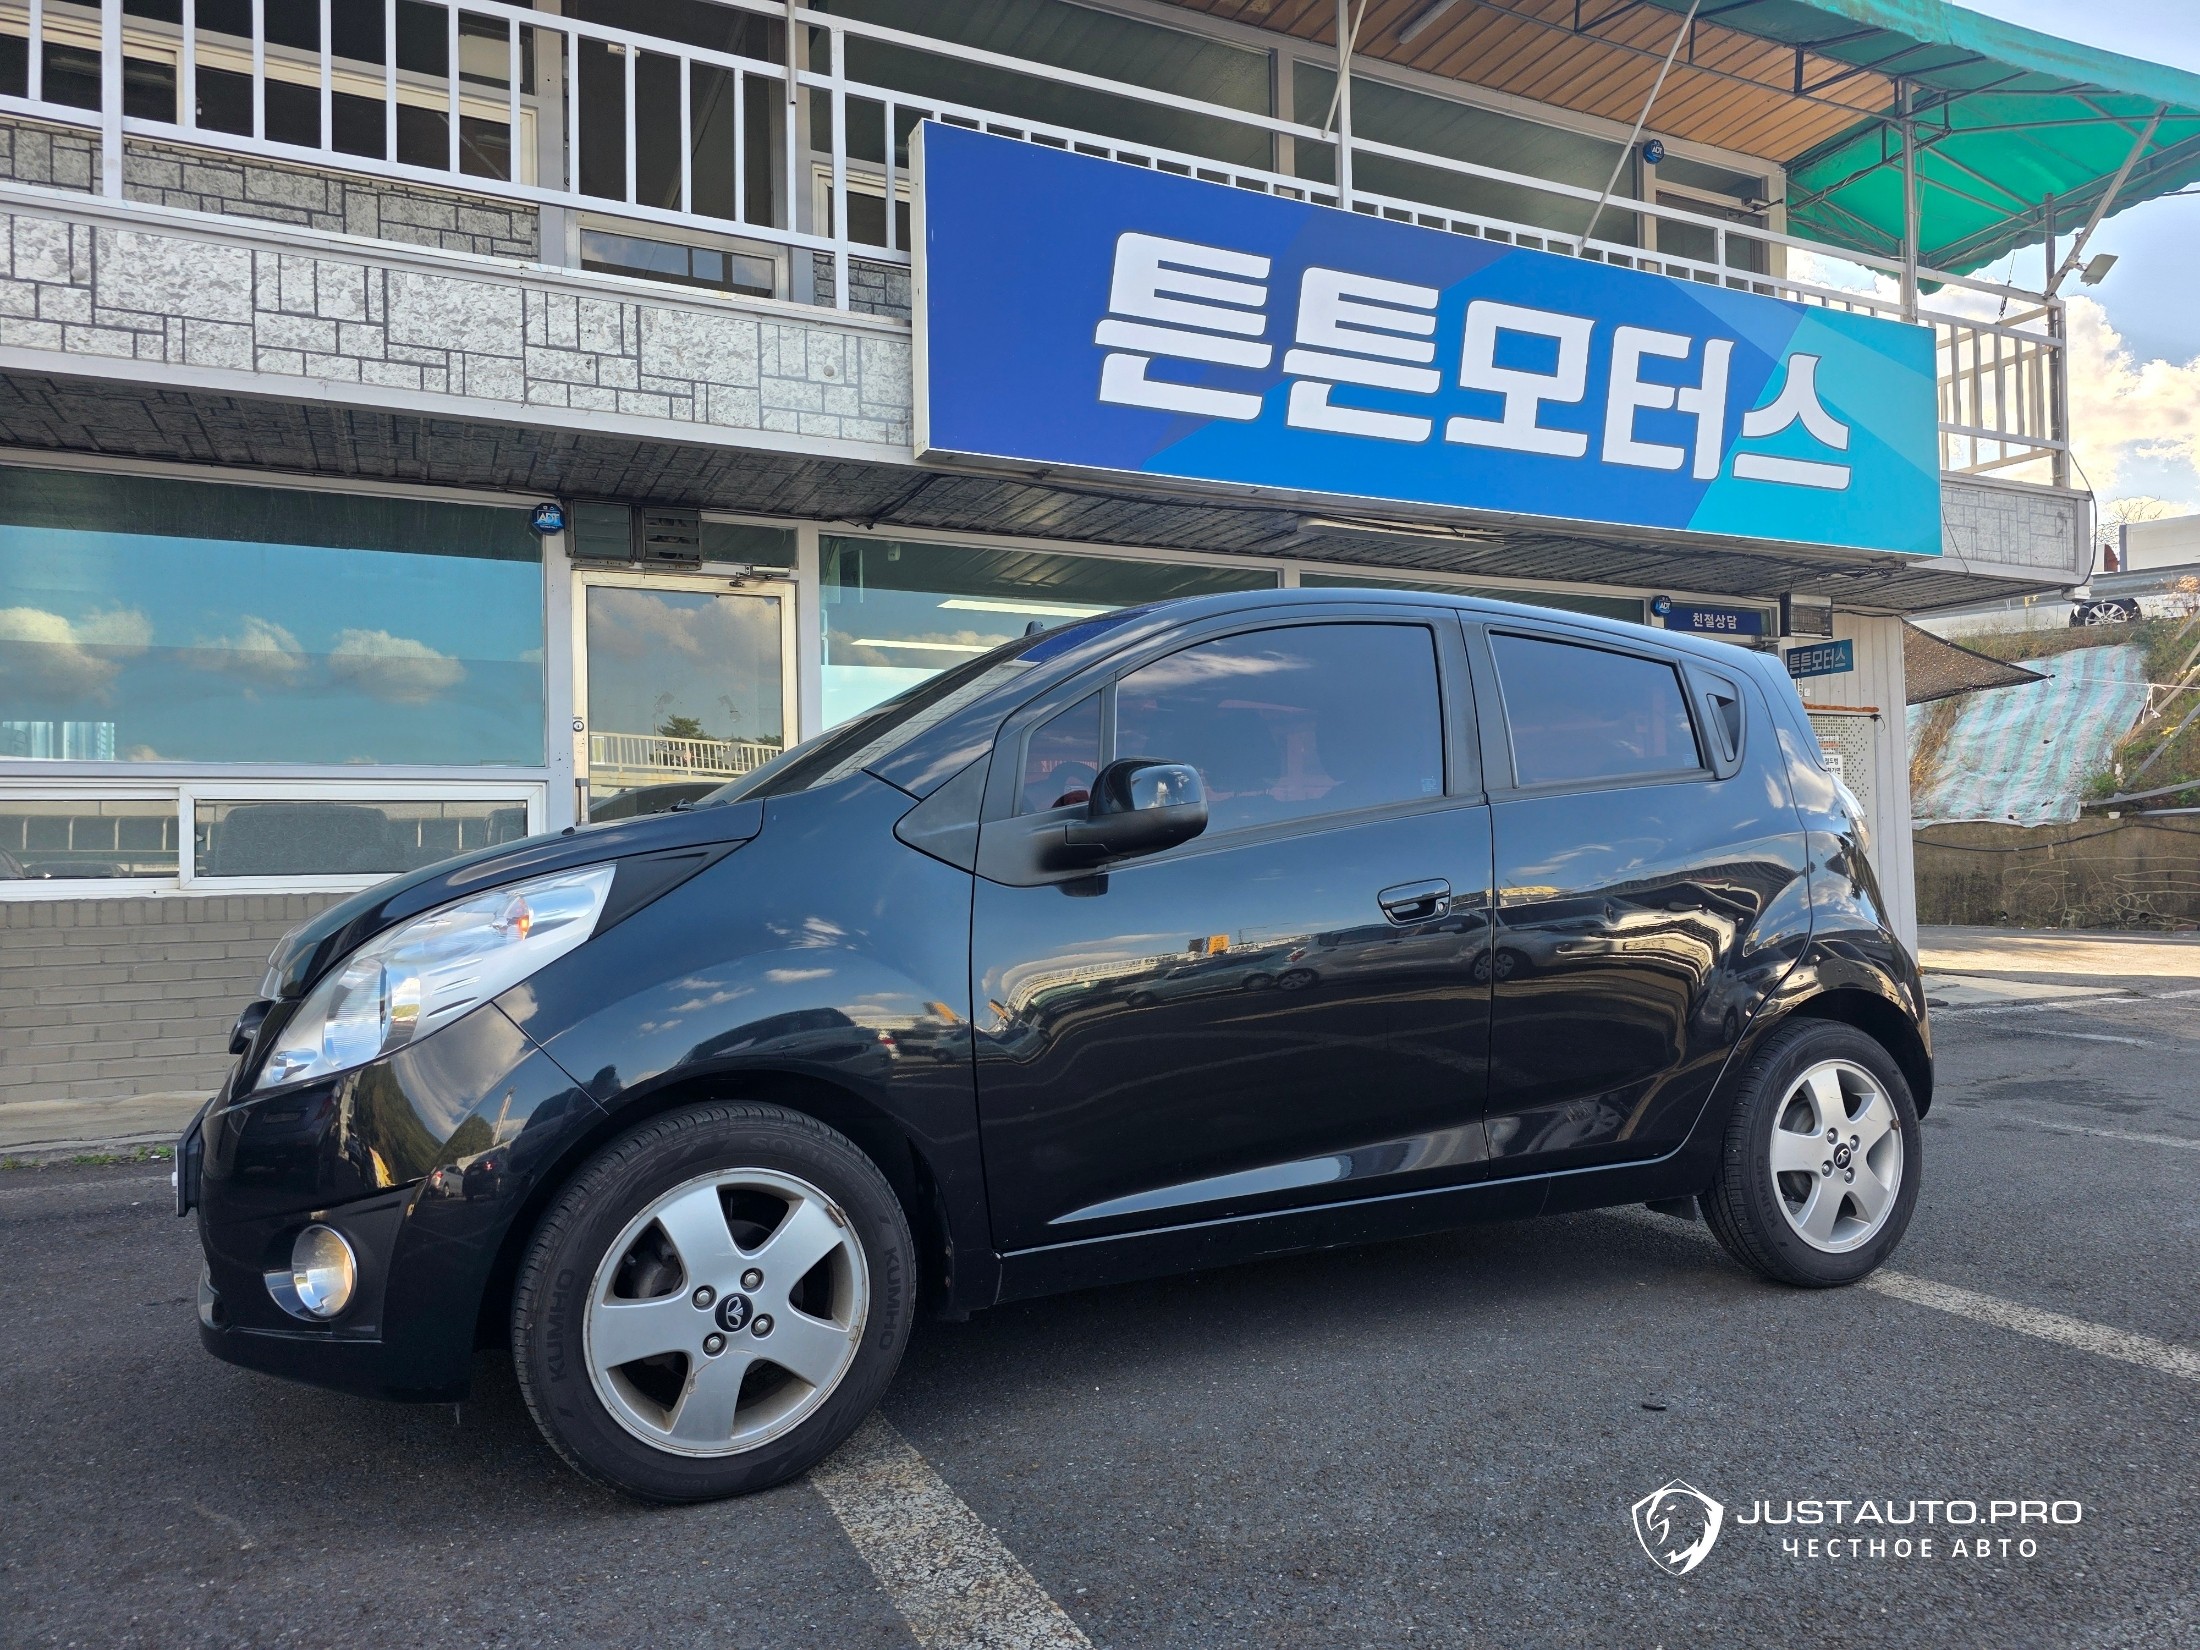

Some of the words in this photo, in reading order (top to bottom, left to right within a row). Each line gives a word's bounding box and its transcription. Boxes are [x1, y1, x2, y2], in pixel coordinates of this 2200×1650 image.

[1095, 231, 1852, 490] 튼튼모터스
[538, 512, 560, 525] ADT
[1692, 612, 1738, 630] 친절상담
[1789, 647, 1846, 675] 튼튼모터스
[545, 1268, 575, 1384] KUMHO
[878, 1246, 900, 1352] KUMHO
